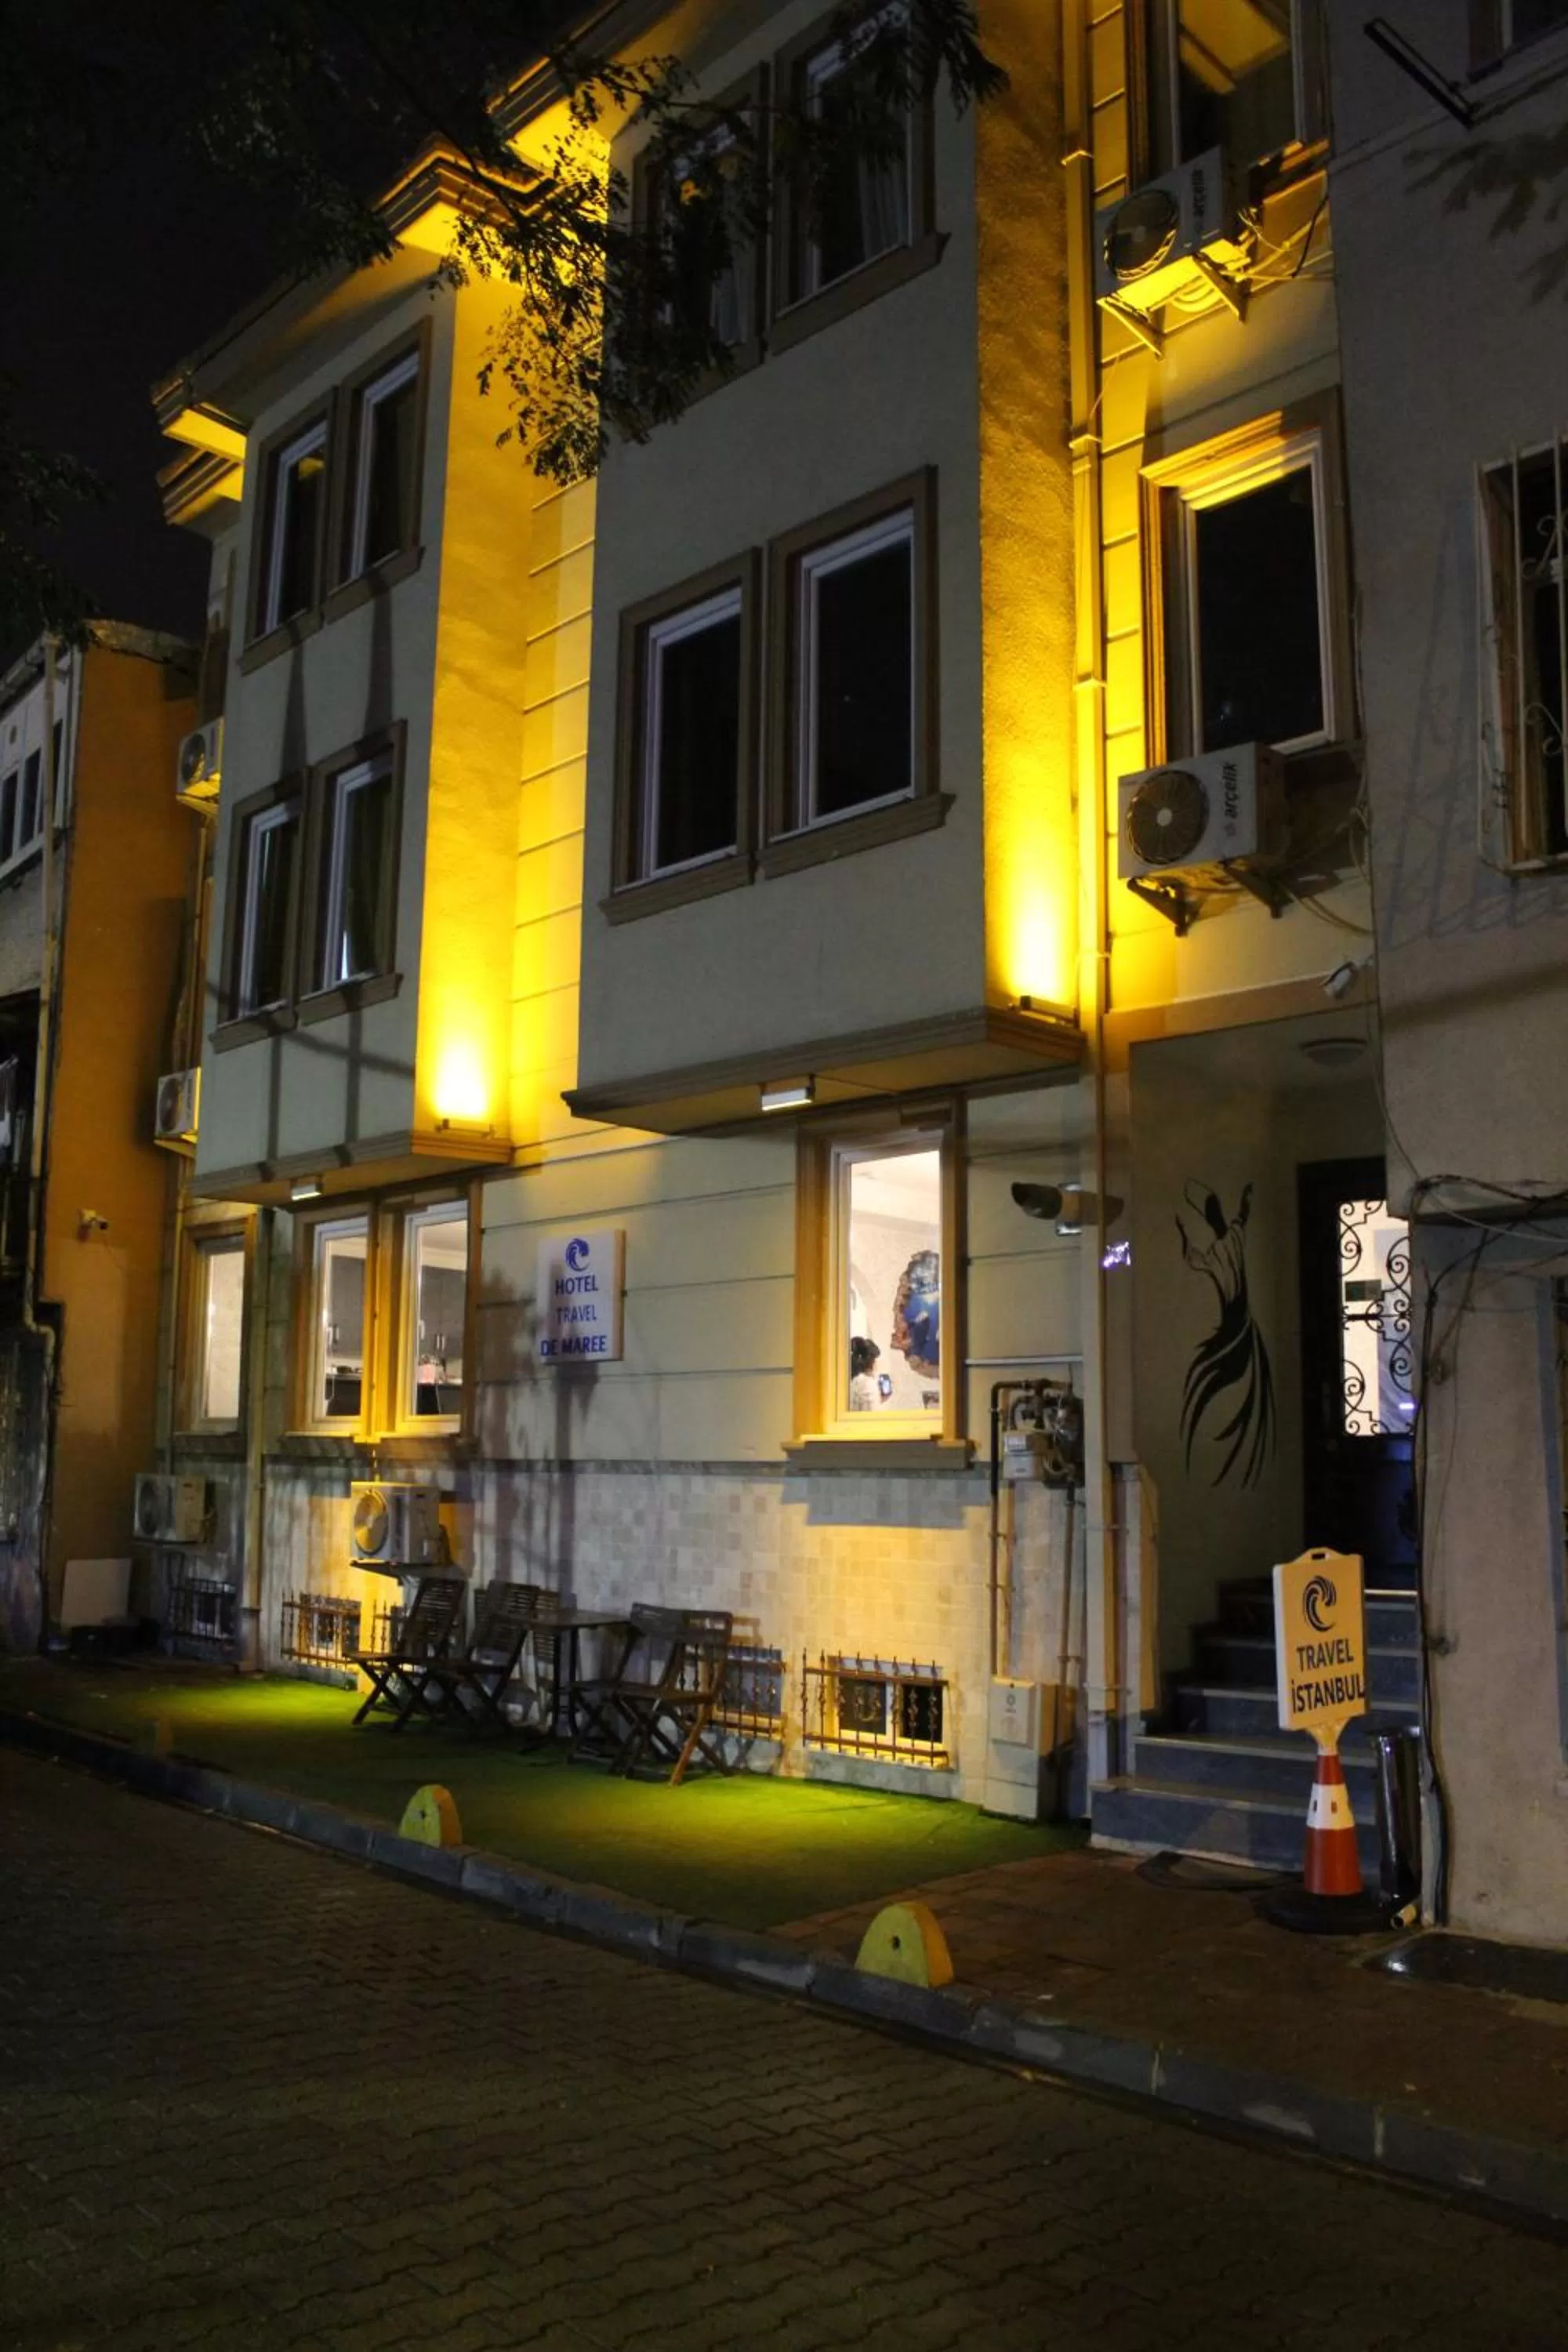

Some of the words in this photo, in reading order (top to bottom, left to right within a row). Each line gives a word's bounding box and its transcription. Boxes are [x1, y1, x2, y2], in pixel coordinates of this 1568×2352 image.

[555, 1275, 599, 1295] HOTEL
[557, 1304, 597, 1324] TRAVEL
[540, 1339, 559, 1356] DE
[561, 1335, 607, 1355] MAREE
[1296, 1638, 1355, 1672] TRAVEL
[1291, 1673, 1366, 1714] İSTANBUL
